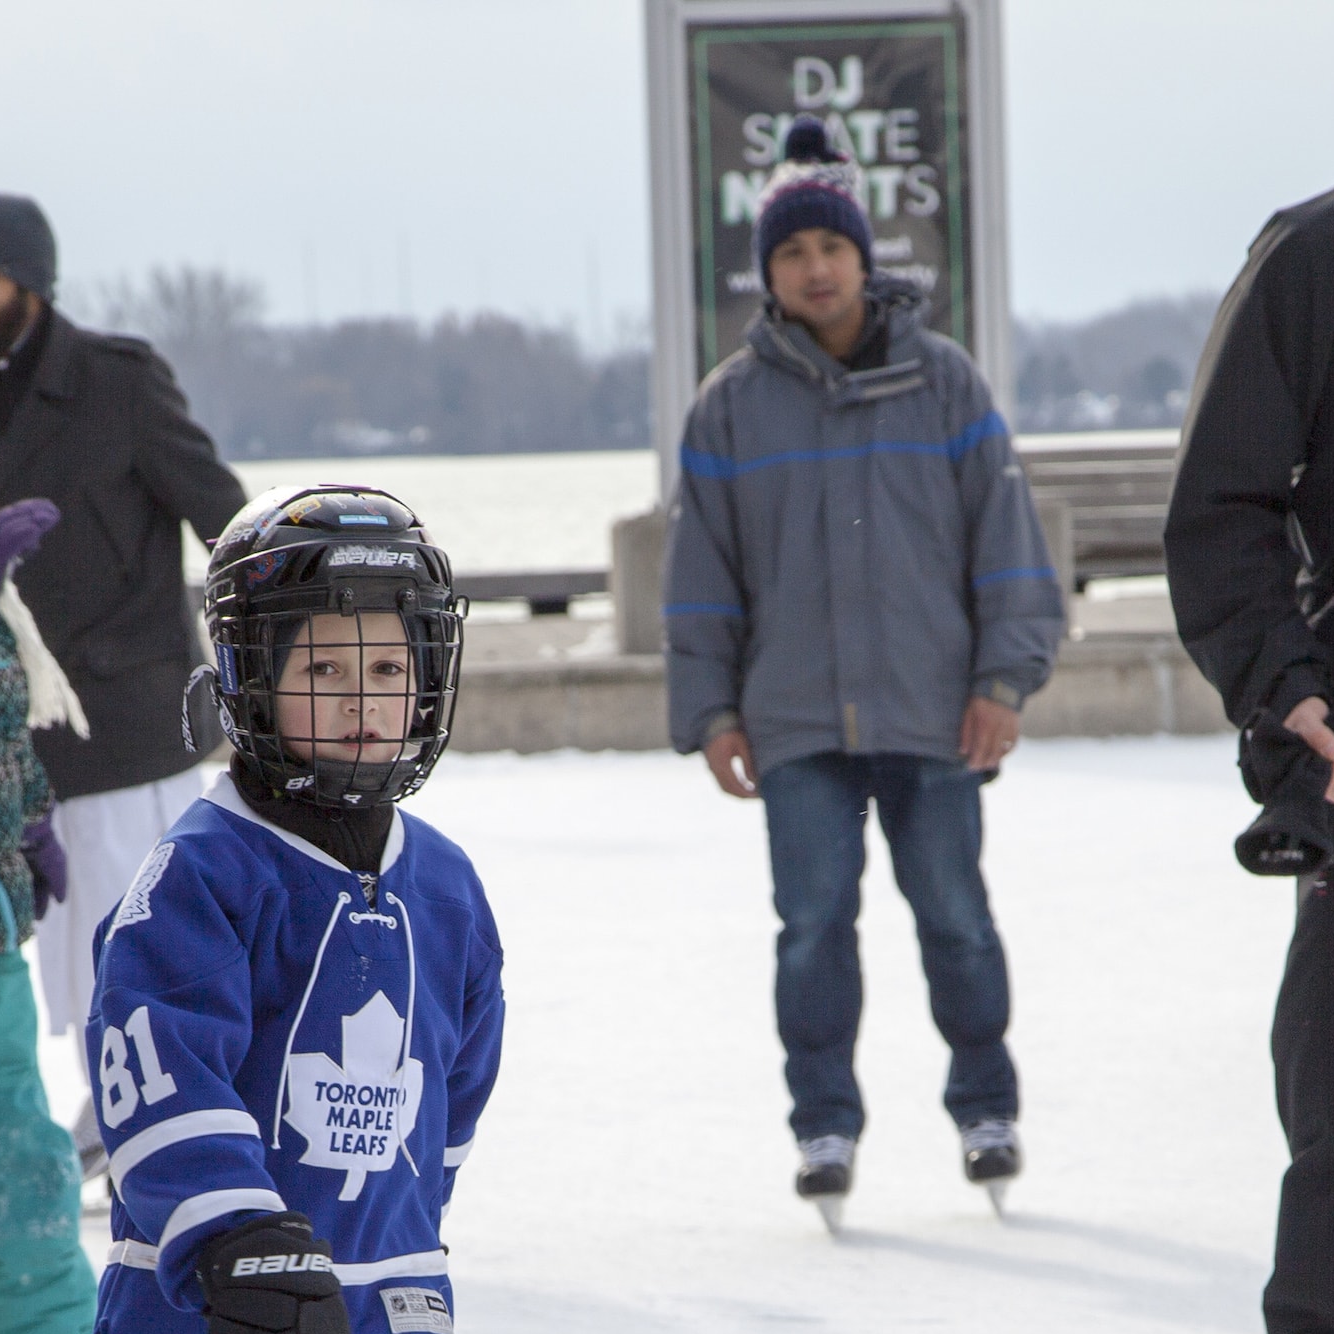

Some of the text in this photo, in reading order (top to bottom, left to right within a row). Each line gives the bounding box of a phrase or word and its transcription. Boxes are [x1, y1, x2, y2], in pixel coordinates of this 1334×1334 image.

[793, 55, 864, 110] DJ
[743, 109, 920, 166] SATE
[721, 165, 940, 225] NTS
[99, 1005, 178, 1129] 81
[326, 1106, 394, 1131] MAPLE
[329, 1131, 388, 1156] LEAFS
